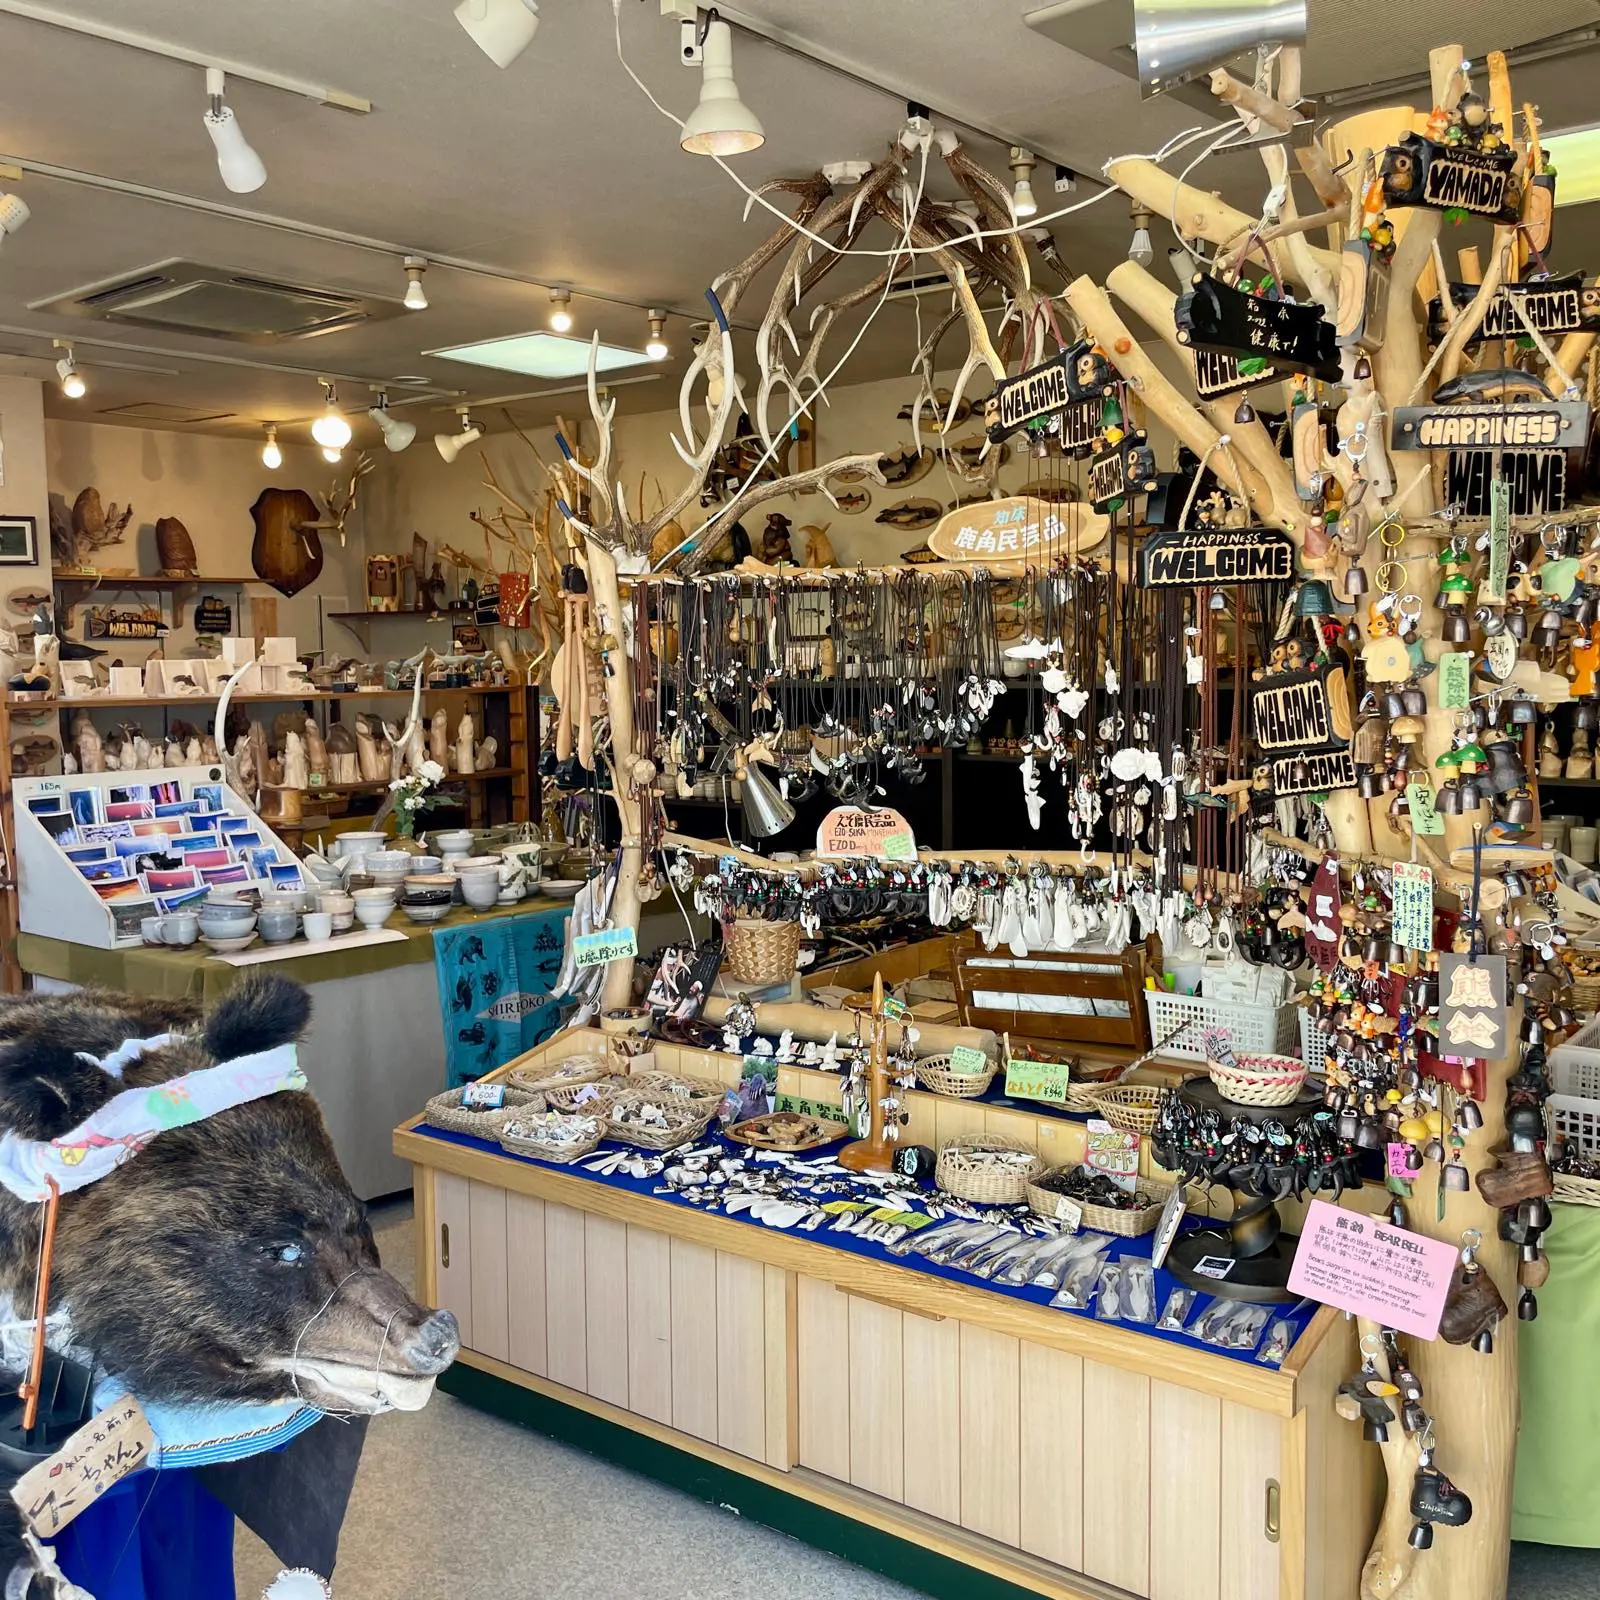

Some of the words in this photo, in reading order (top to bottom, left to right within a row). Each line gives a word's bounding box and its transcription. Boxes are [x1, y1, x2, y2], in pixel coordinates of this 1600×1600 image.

[1429, 164, 1502, 210] YAMADA
[1486, 293, 1577, 332] WELCOME
[1002, 370, 1067, 425] WELCOME
[1420, 416, 1556, 445] HAPPINESS
[1095, 459, 1124, 500] WELCOME
[954, 514, 1067, 553] 鹿角民芸品
[1183, 533, 1261, 546] HAPPINESS
[1152, 546, 1288, 580] WELCOME
[1255, 684, 1327, 745] WELCOME
[1095, 1151, 1133, 1171] OFF
[1373, 1229, 1401, 1246] BEAR
[1400, 1239, 1428, 1255] BELL
